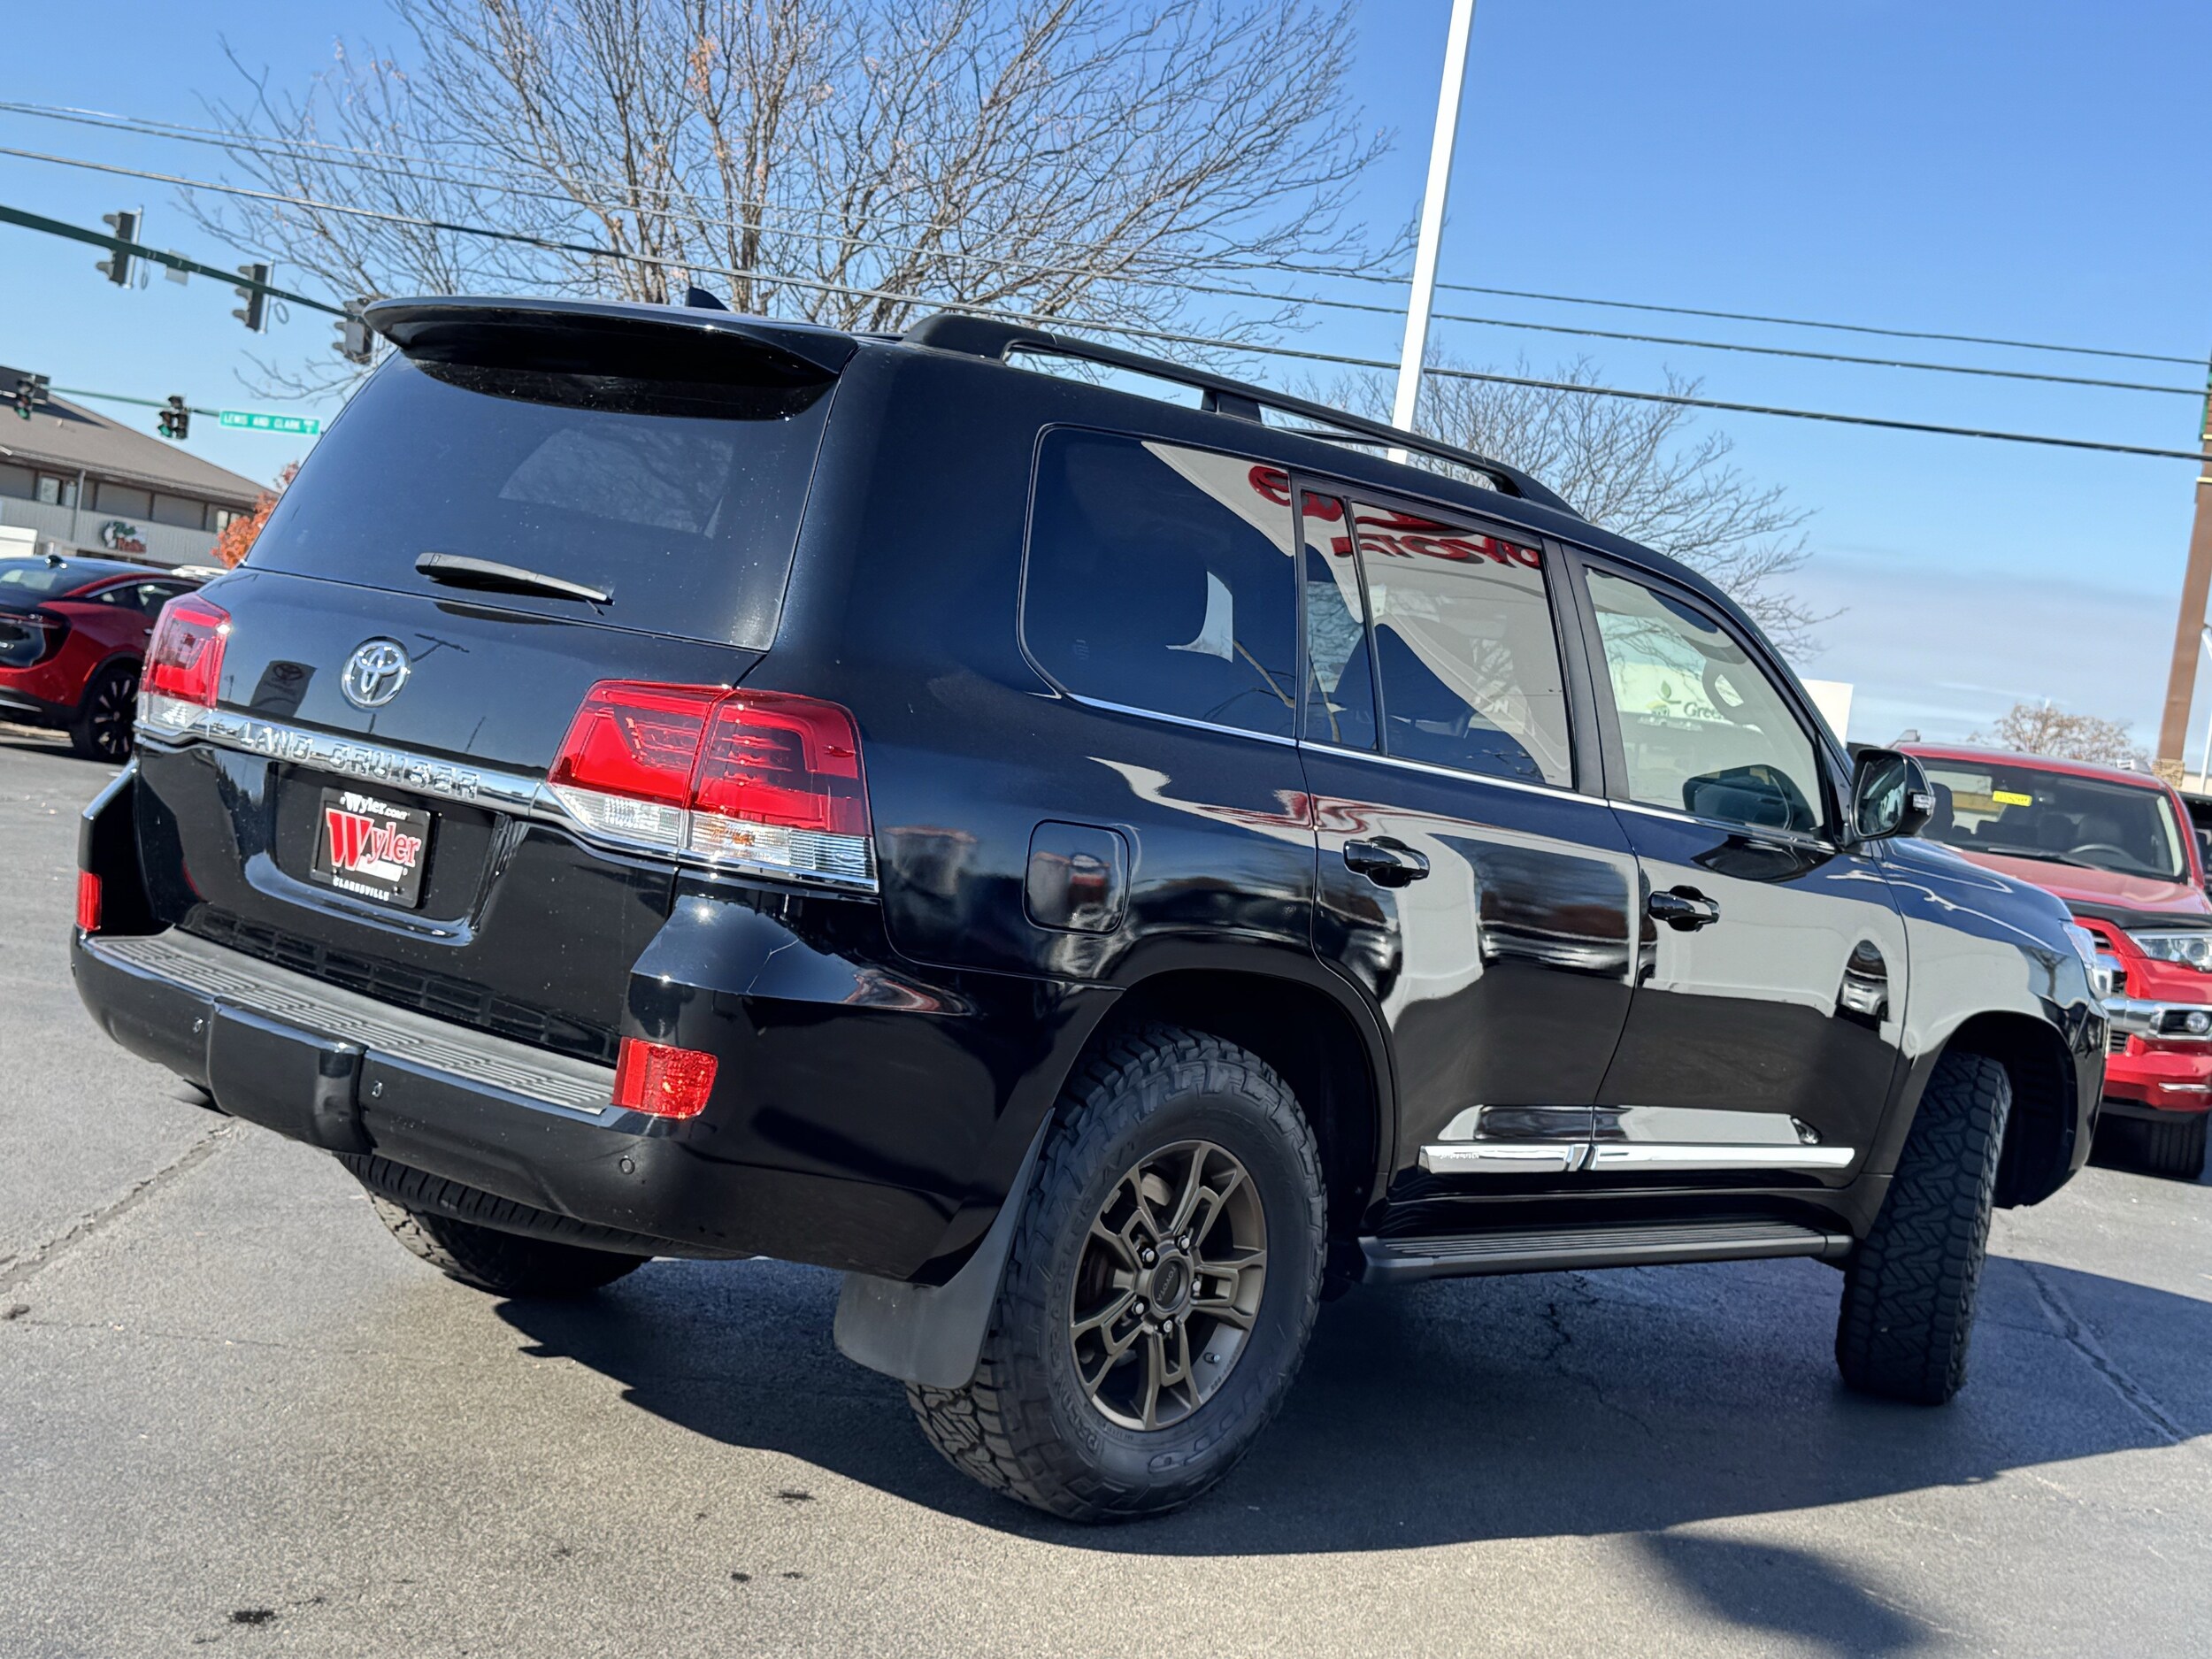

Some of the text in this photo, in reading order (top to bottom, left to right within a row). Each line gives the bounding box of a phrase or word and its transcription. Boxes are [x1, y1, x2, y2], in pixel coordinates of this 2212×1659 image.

[224, 412, 248, 425] LEWIS
[252, 416, 270, 427] AND
[274, 419, 300, 431] CLARK
[1684, 702, 1724, 721] Gree
[238, 721, 480, 800] LAND CRUISER
[343, 791, 408, 820] Wyler.com
[325, 807, 422, 871] Wyler
[332, 875, 390, 902] CLARKSVILLE
[1156, 1265, 1178, 1302] TOYOTA
